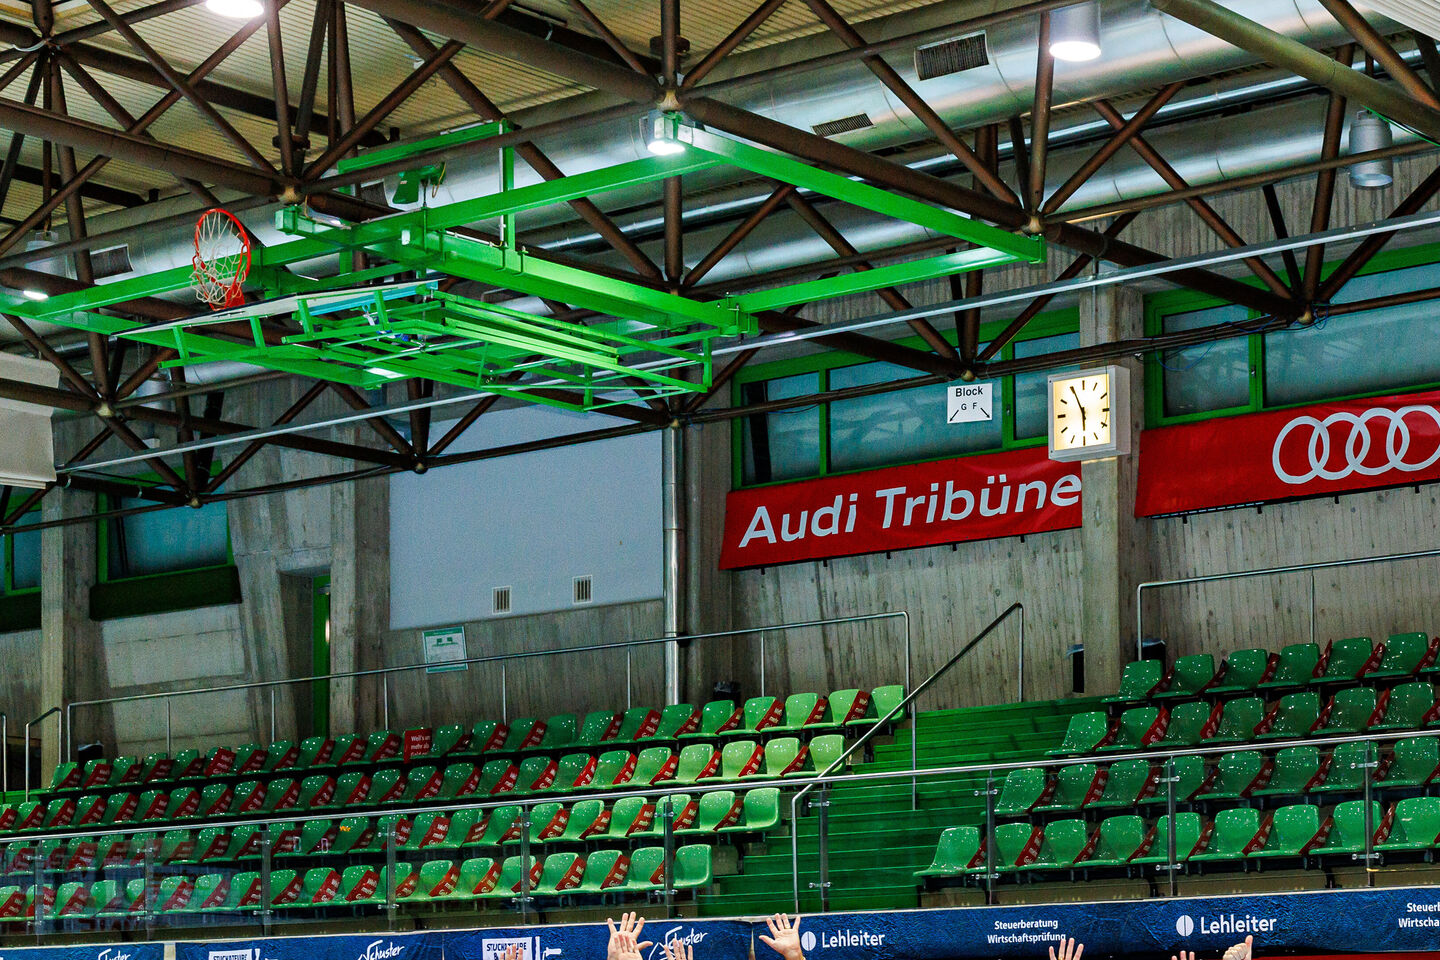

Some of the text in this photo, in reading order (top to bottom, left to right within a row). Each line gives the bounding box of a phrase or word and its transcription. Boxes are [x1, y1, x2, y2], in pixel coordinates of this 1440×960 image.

[955, 386, 983, 397] Block
[961, 402, 977, 411] G F
[738, 473, 1082, 548] Audi Tribüne
[994, 919, 1059, 930] Steuerberatung
[1200, 914, 1277, 934] Lehleiter
[821, 929, 886, 948] Lehleiter
[987, 931, 1066, 944] Wirtschaftsprüfung
